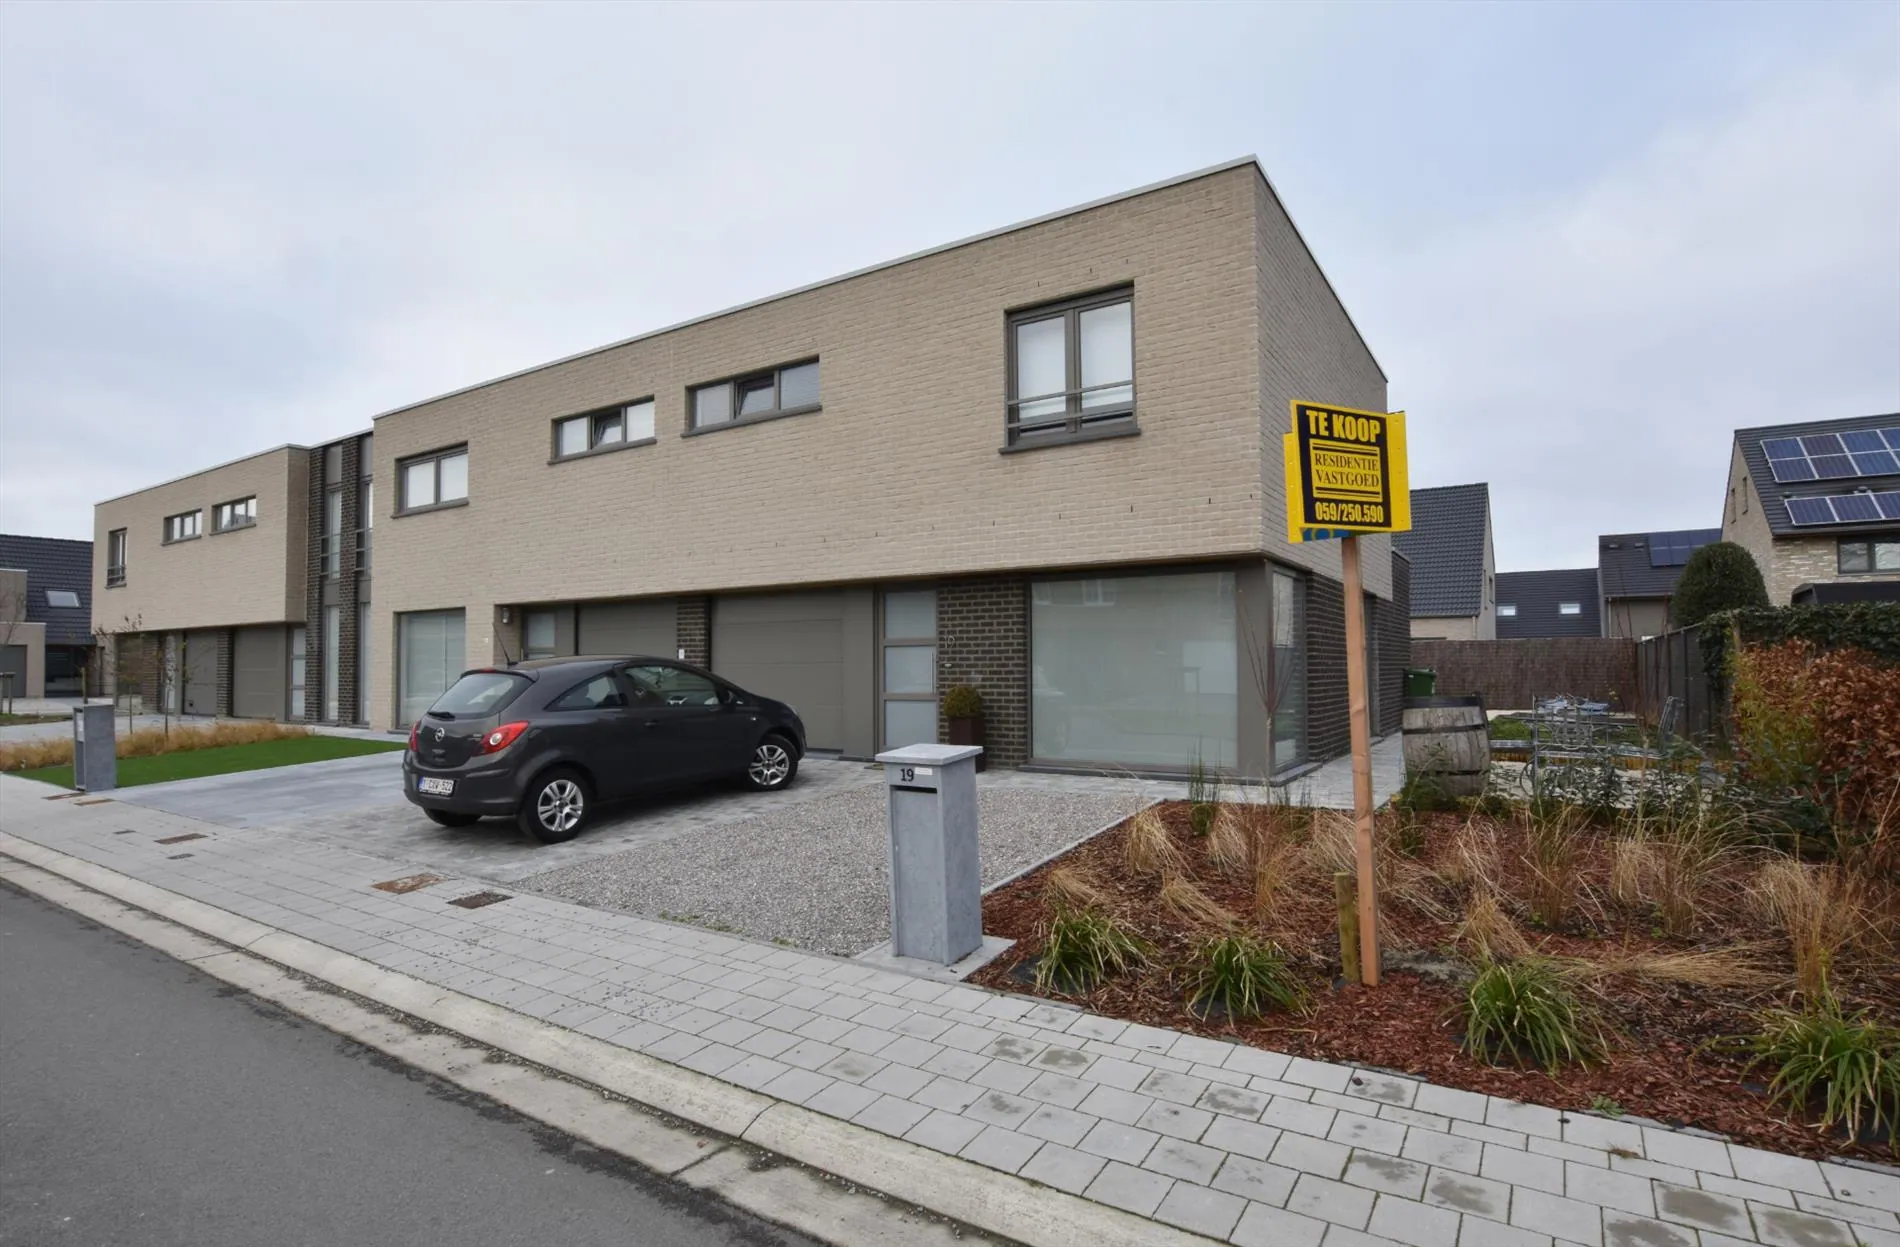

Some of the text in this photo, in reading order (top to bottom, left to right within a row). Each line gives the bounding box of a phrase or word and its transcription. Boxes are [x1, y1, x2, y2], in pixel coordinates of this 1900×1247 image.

[1306, 409, 1380, 443] TE KOOP
[1314, 452, 1379, 471] RESIDENTIE
[1315, 469, 1379, 487] VASTGOED
[1315, 501, 1384, 523] 059/250.590
[900, 767, 914, 782] 19
